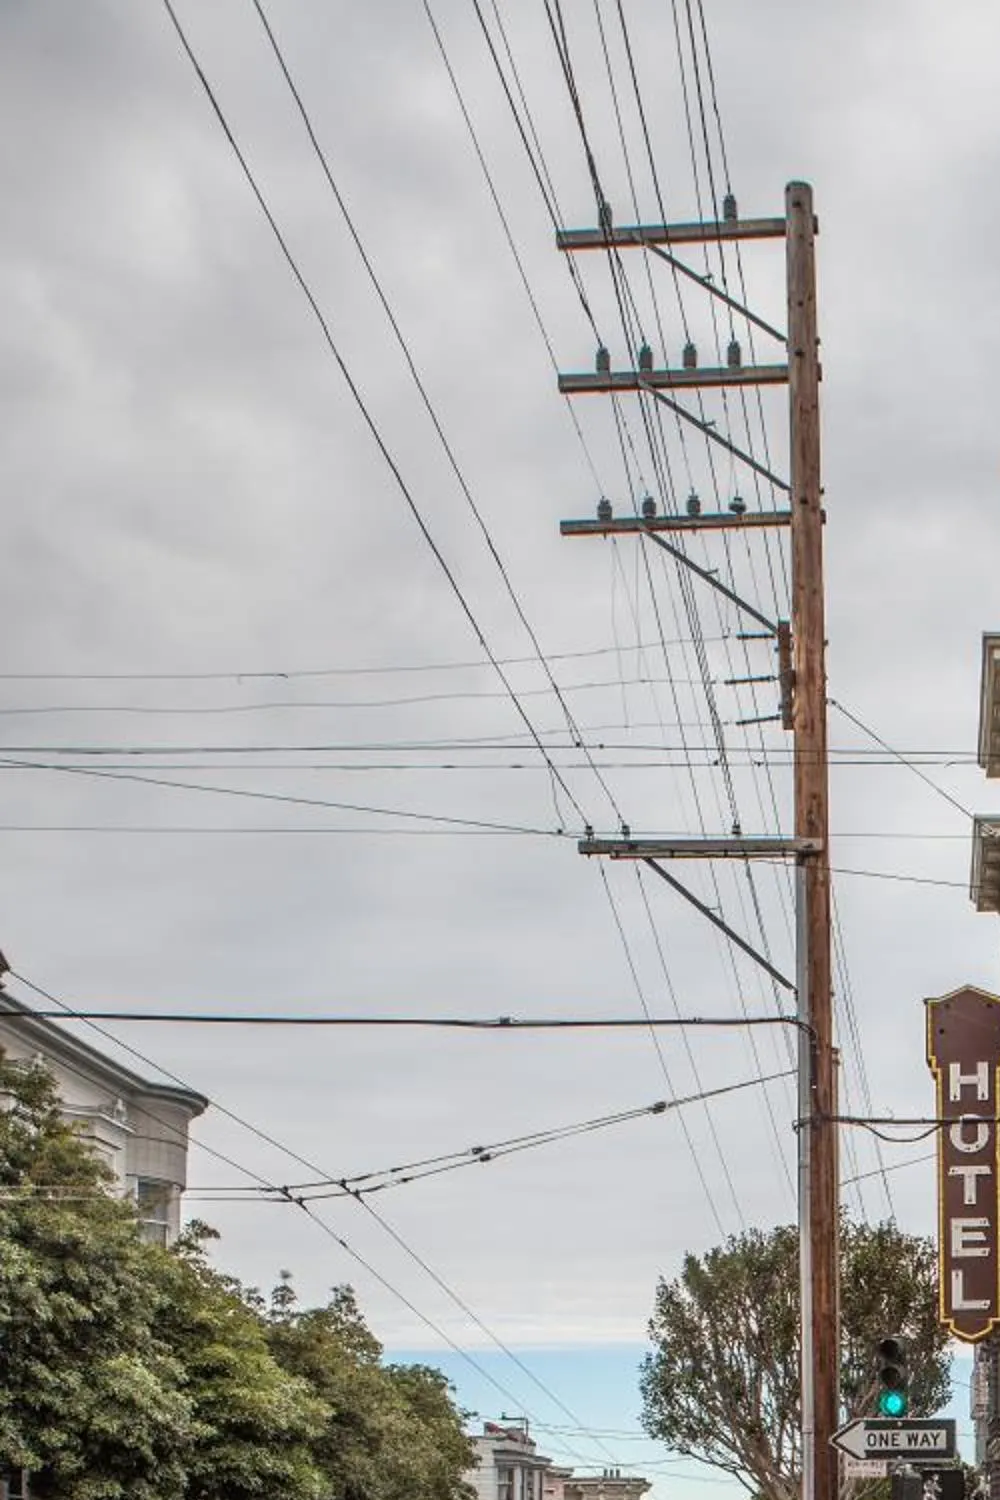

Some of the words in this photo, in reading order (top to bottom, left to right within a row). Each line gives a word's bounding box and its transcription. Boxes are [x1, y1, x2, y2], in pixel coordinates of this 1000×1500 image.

[948, 1061, 992, 1310] HOTEL
[867, 1433, 900, 1447] ONE
[906, 1432, 941, 1447] WAY
